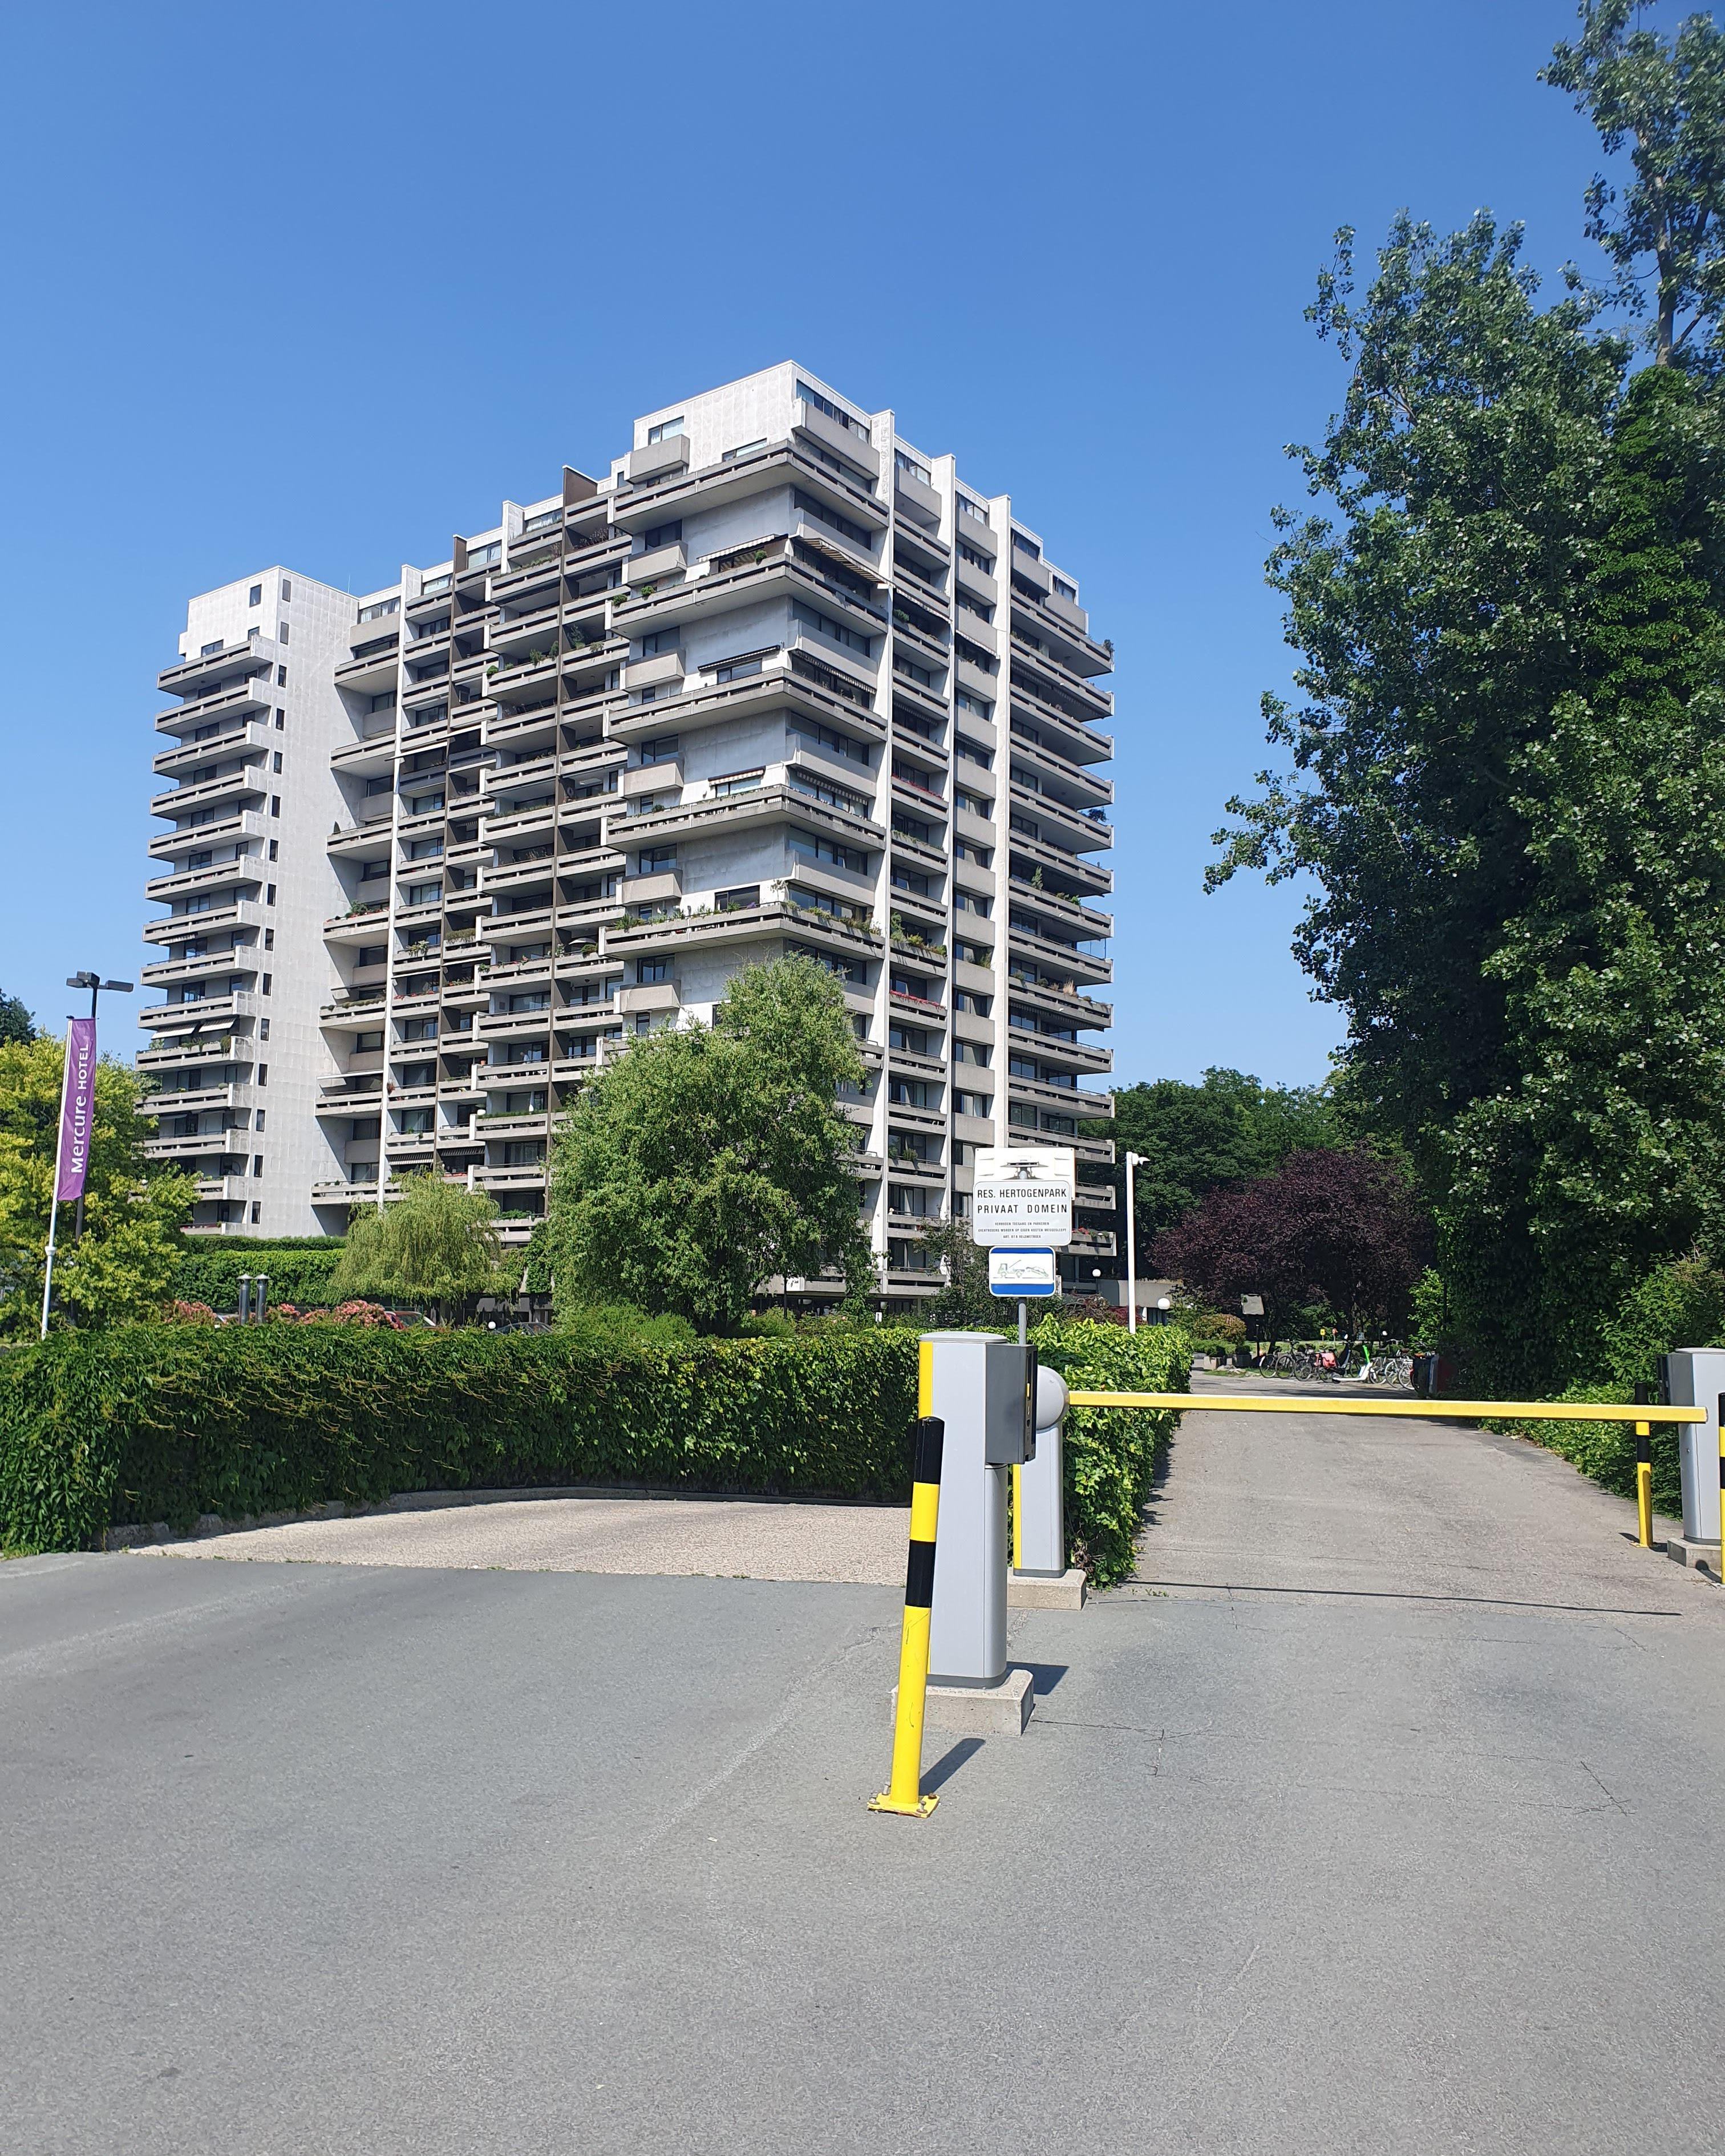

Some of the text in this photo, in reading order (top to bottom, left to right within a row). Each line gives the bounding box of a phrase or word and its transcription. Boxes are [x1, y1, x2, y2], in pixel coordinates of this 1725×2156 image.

[71, 1044, 89, 1173] Mercure HOTEL
[977, 1189, 1067, 1198] RES. HERTOGENPARK
[977, 1204, 1067, 1214] PRIVAAT DOMEIN
